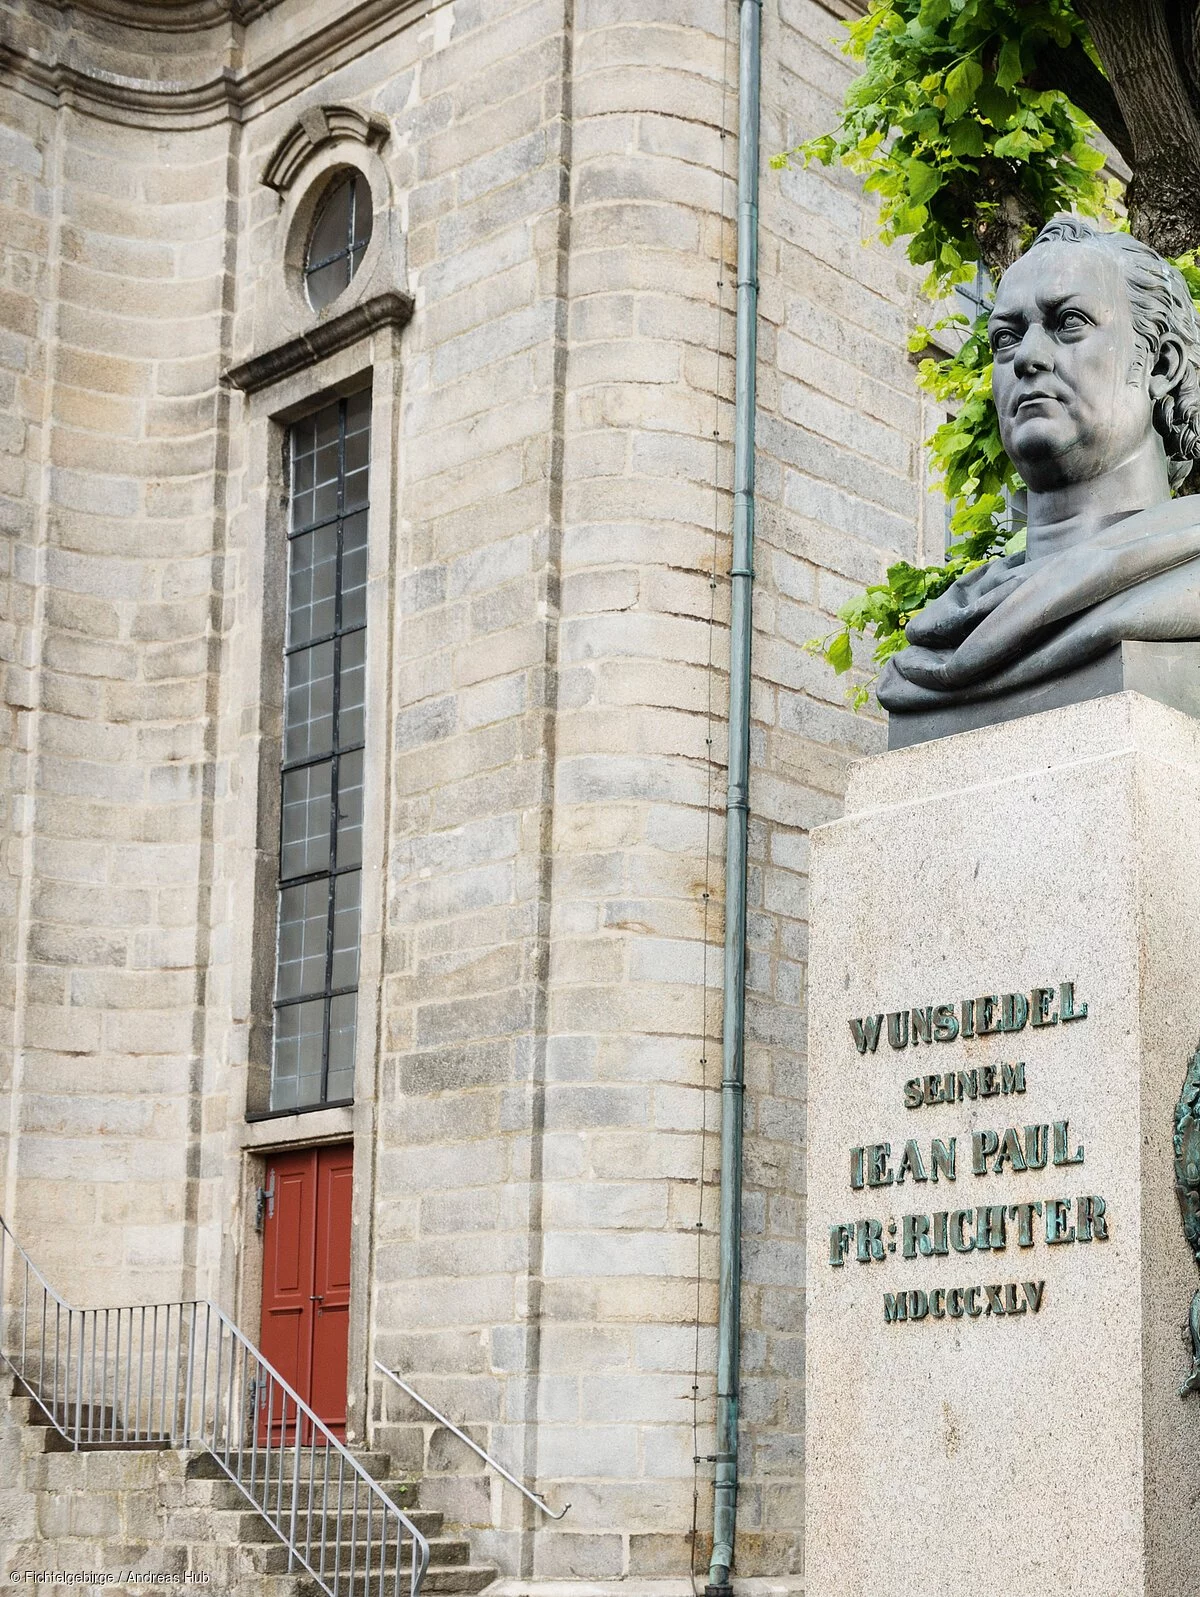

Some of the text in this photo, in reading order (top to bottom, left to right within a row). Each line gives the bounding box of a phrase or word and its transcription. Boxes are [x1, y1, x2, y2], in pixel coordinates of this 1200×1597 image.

[848, 981, 1089, 1054] WUNSIEDEL
[903, 1062, 1027, 1109] SEINEM
[849, 1119, 1085, 1190] IEAN PAUL
[883, 1281, 1045, 1322] MDCCCXLV
